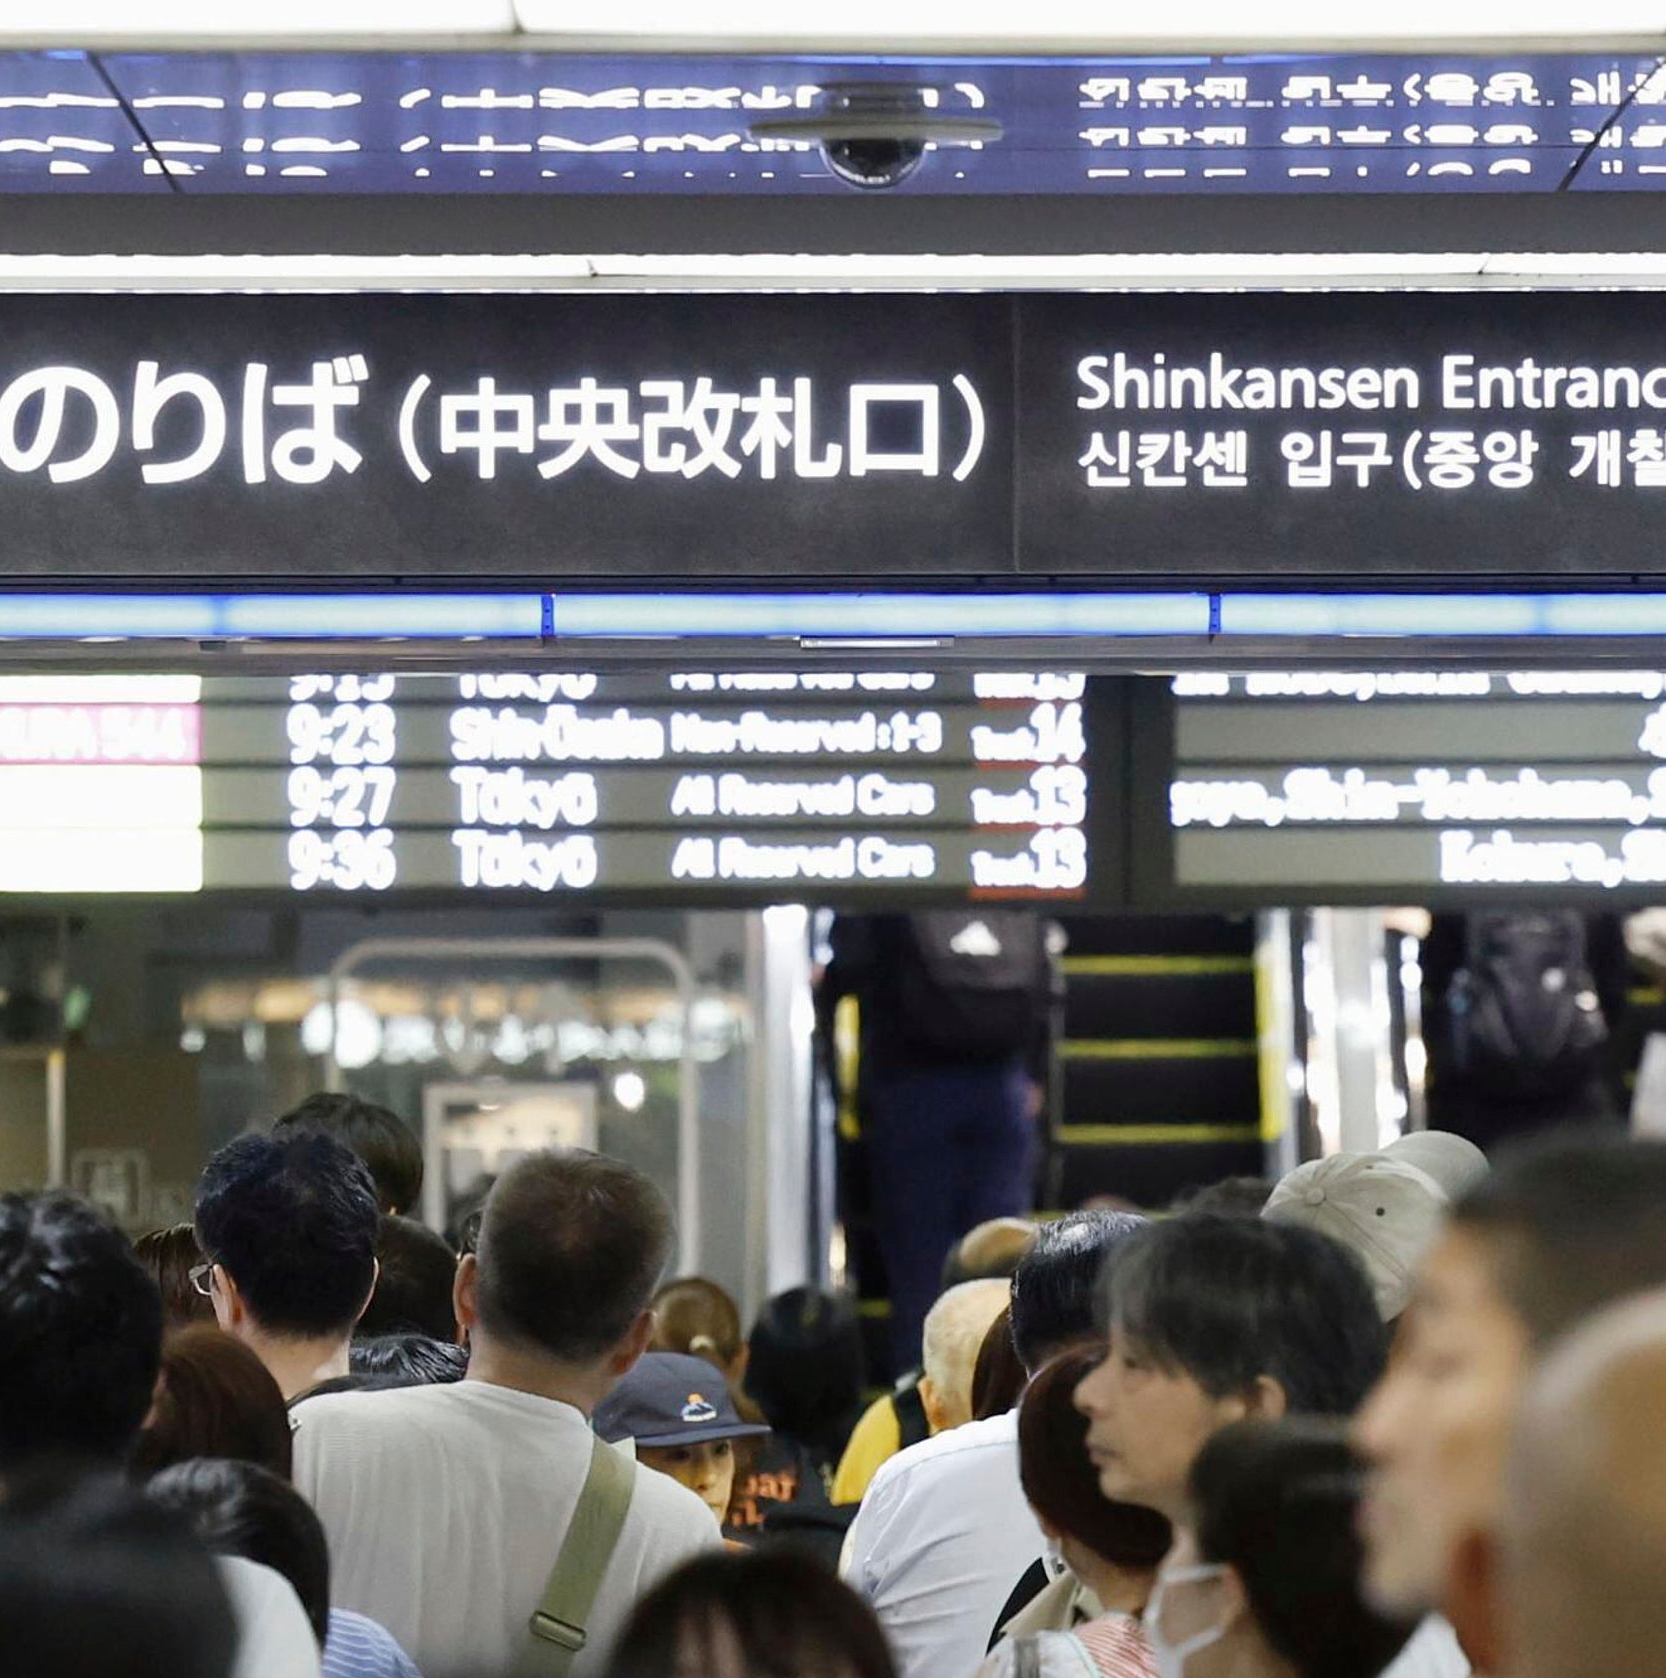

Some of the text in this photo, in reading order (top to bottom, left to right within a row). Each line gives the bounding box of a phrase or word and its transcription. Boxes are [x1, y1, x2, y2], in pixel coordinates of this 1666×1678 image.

[1077, 352, 1419, 410] Shinkansen
[1078, 430, 1248, 487] 신칸센
[1280, 429, 1540, 490] 입구(중앙
[286, 702, 396, 765] 9:23
[287, 766, 397, 827] 9:27
[287, 828, 397, 890] 9:36
